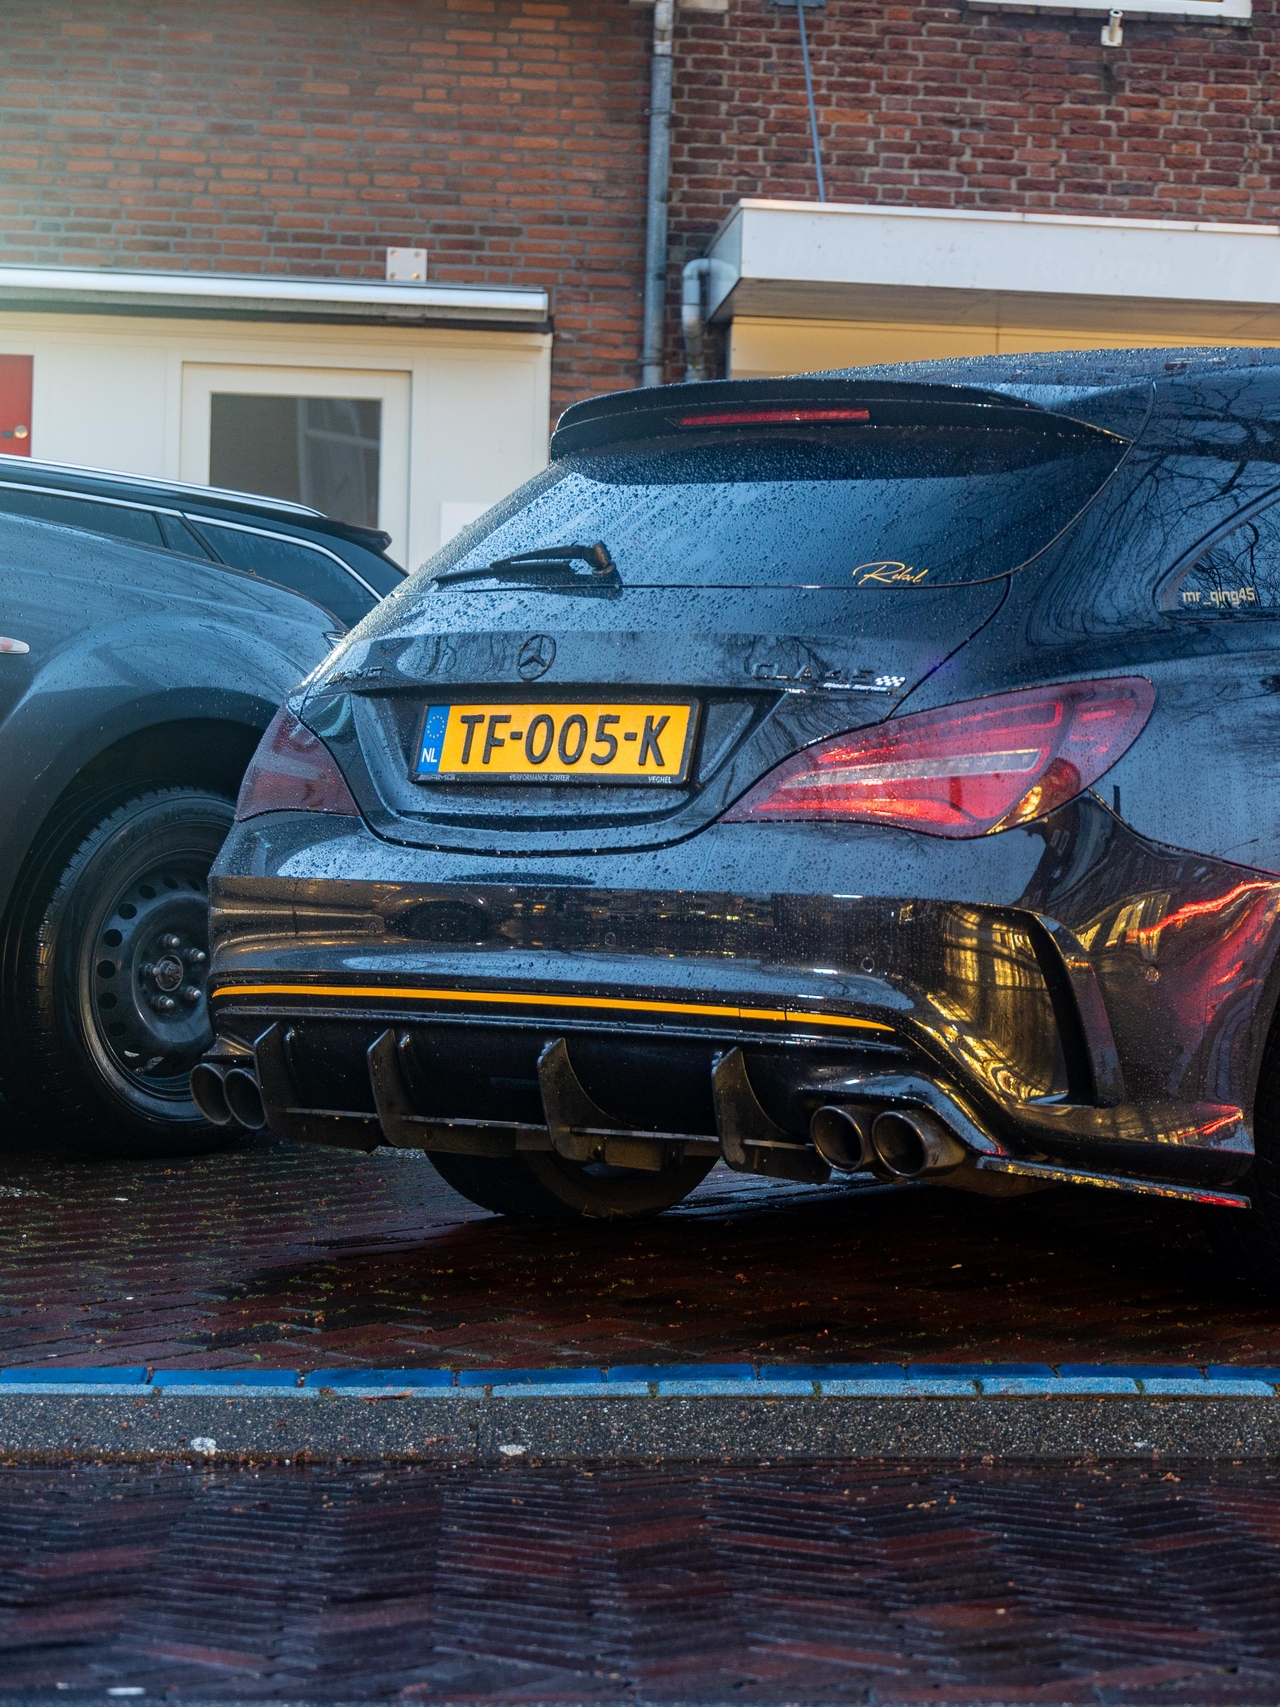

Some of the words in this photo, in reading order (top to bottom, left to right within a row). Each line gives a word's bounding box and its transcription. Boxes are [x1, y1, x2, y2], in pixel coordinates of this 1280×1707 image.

[460, 714, 671, 766] TF-005-K
[421, 747, 438, 763] NL
[509, 774, 549, 782] PERFORMANCE
[648, 776, 672, 784] VEGHEL
